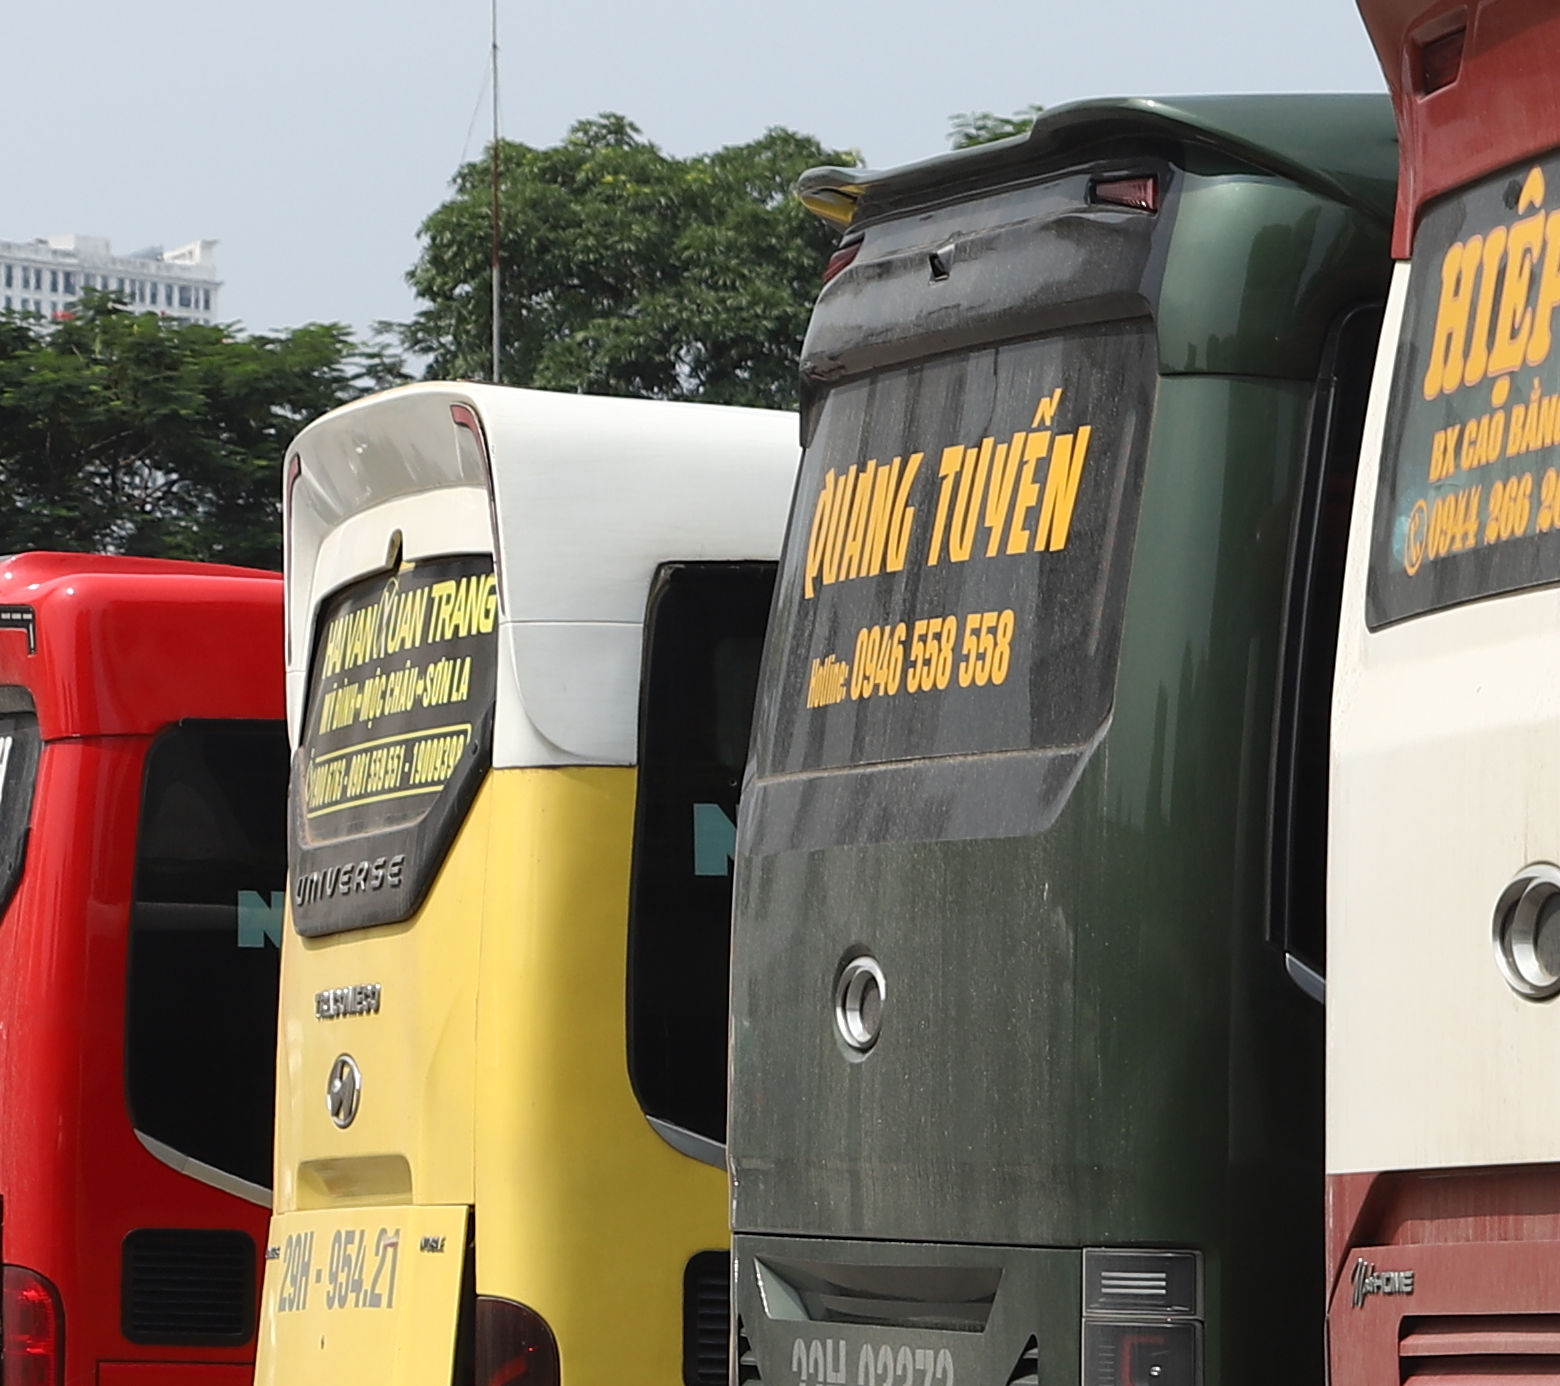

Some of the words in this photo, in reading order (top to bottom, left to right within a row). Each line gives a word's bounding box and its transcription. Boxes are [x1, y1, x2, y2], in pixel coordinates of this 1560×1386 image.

[1429, 424, 1461, 483] BX
[1461, 408, 1506, 471] CAO
[805, 452, 924, 599] QUANG
[1428, 484, 1482, 561] 0944
[1484, 471, 1533, 545] 266
[422, 656, 453, 708] SƠN
[451, 656, 472, 703] LA
[850, 622, 907, 700] 0946
[907, 615, 957, 693] 558
[958, 609, 1015, 687] 558
[295, 854, 406, 908] UNIVERSE
